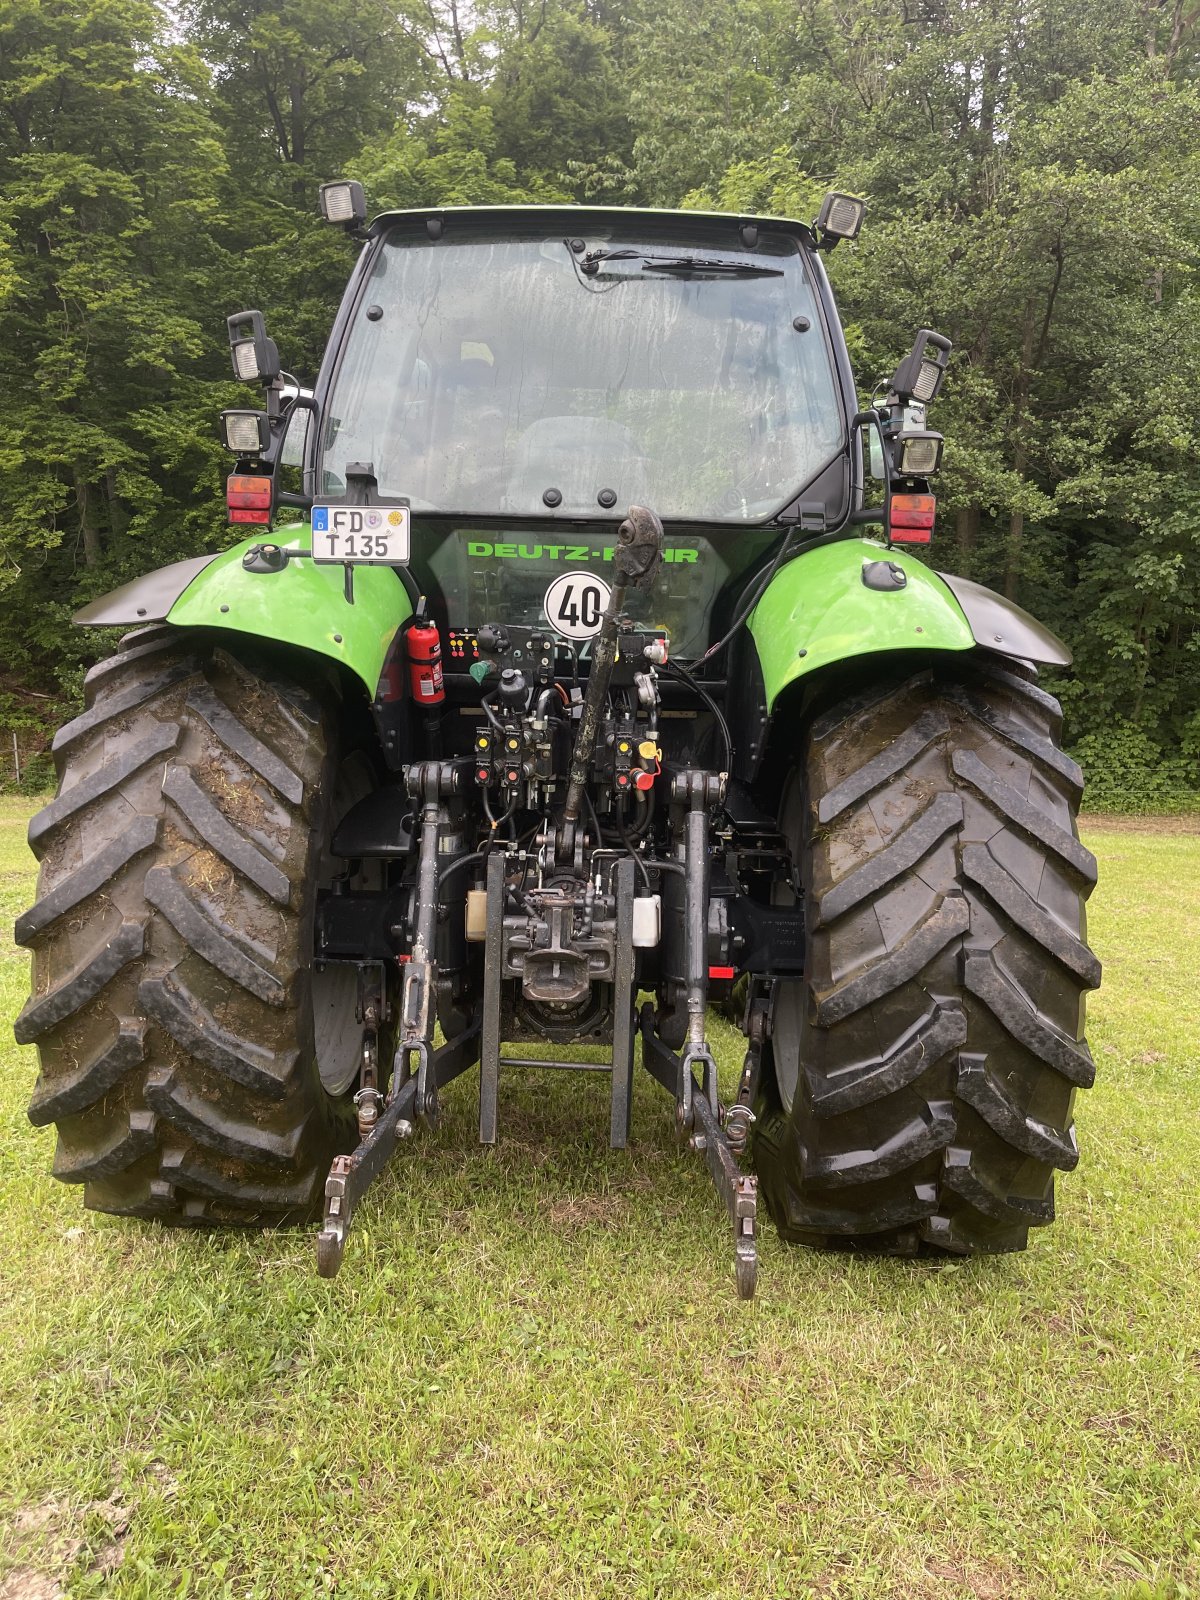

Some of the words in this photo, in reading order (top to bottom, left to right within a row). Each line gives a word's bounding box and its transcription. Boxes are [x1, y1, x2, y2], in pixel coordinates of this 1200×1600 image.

[317, 522, 324, 530] D
[333, 511, 363, 532] FD
[467, 542, 699, 563] DEUTZ-FR
[558, 585, 601, 627] 40
